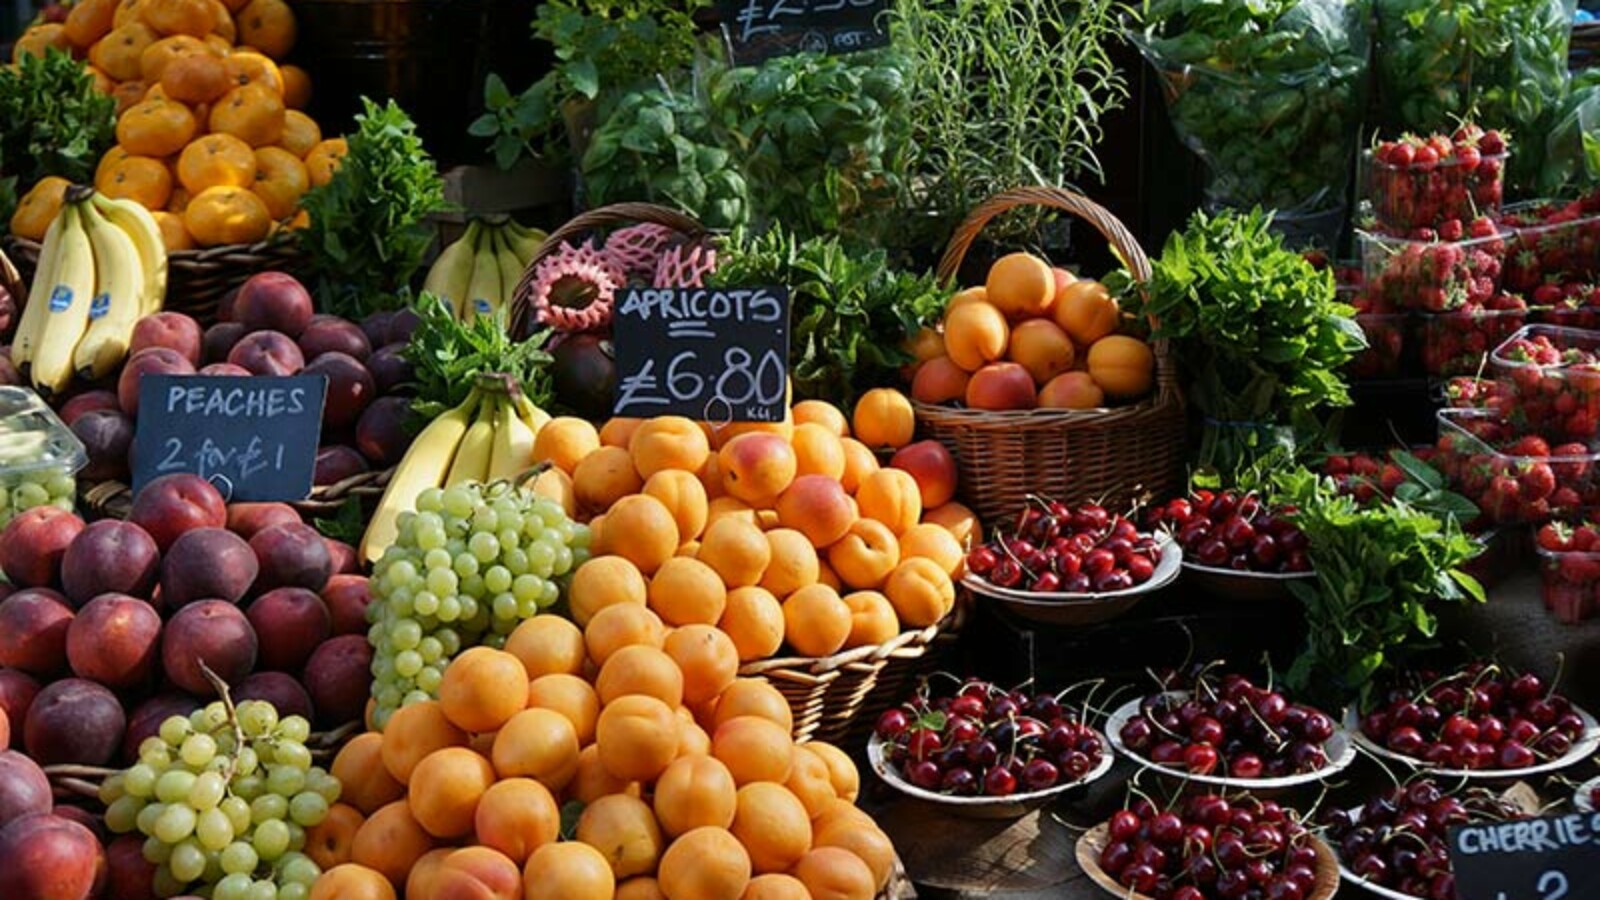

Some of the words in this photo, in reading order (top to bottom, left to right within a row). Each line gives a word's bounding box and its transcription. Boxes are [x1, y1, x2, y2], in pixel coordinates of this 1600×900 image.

[619, 289, 782, 321] APRICOTS
[614, 347, 785, 414] £6.80
[167, 386, 305, 417] PEACHES
[157, 437, 187, 470] 2
[195, 437, 236, 476] for
